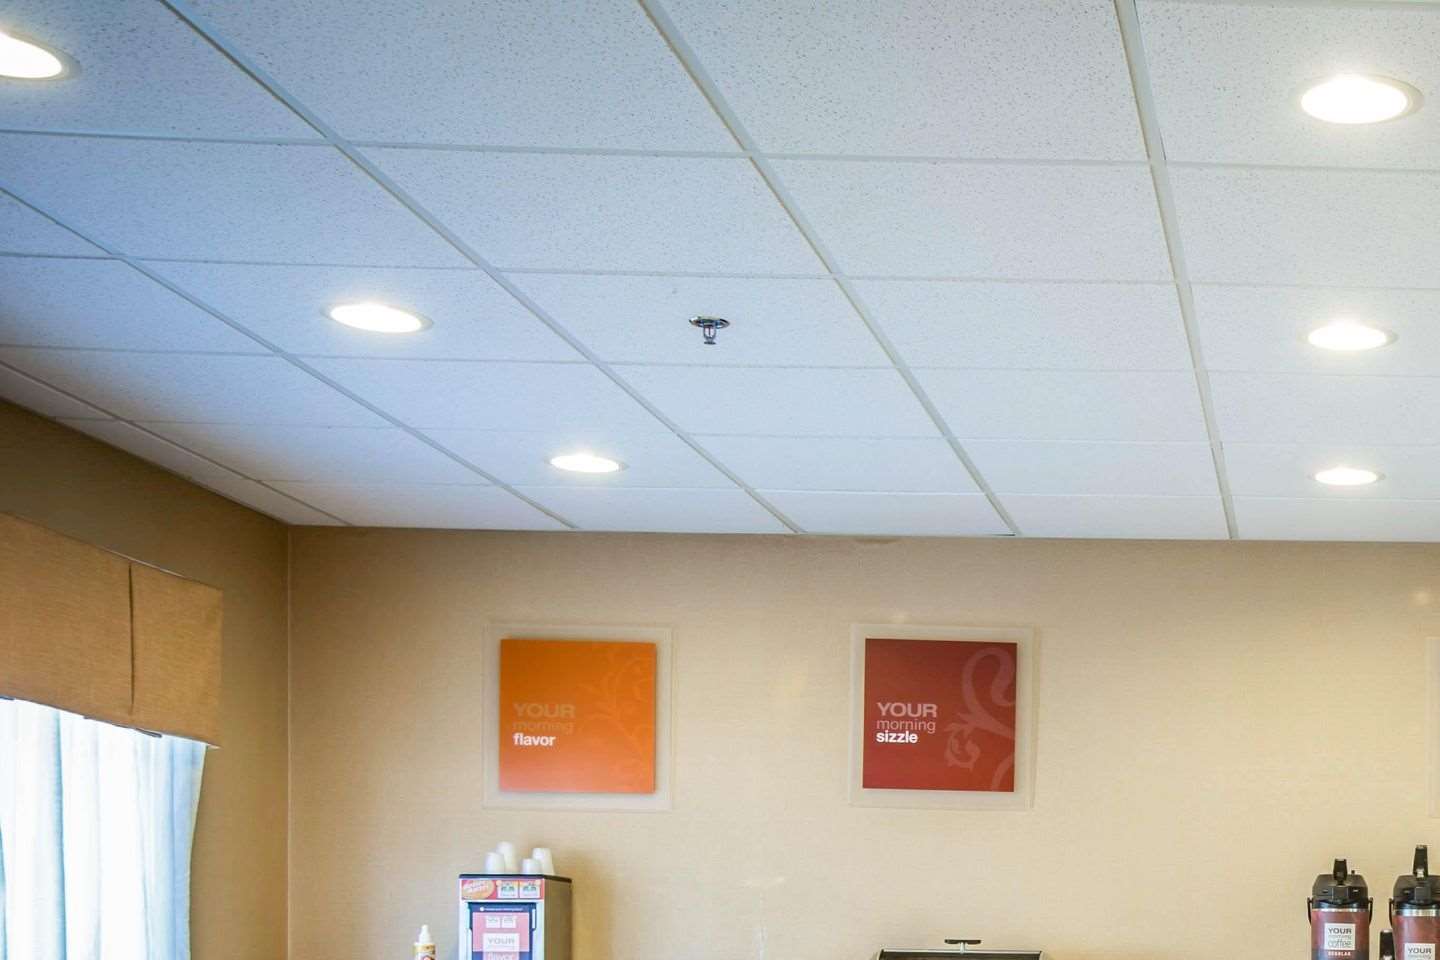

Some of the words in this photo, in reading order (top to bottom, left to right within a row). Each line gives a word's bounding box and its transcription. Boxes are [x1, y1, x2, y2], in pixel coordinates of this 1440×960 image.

[513, 703, 576, 718] YOUR
[877, 702, 938, 718] YOUR
[876, 719, 937, 734] morning
[513, 732, 556, 747] flavor
[876, 730, 918, 744] sizzle
[1328, 927, 1352, 935] YOUR
